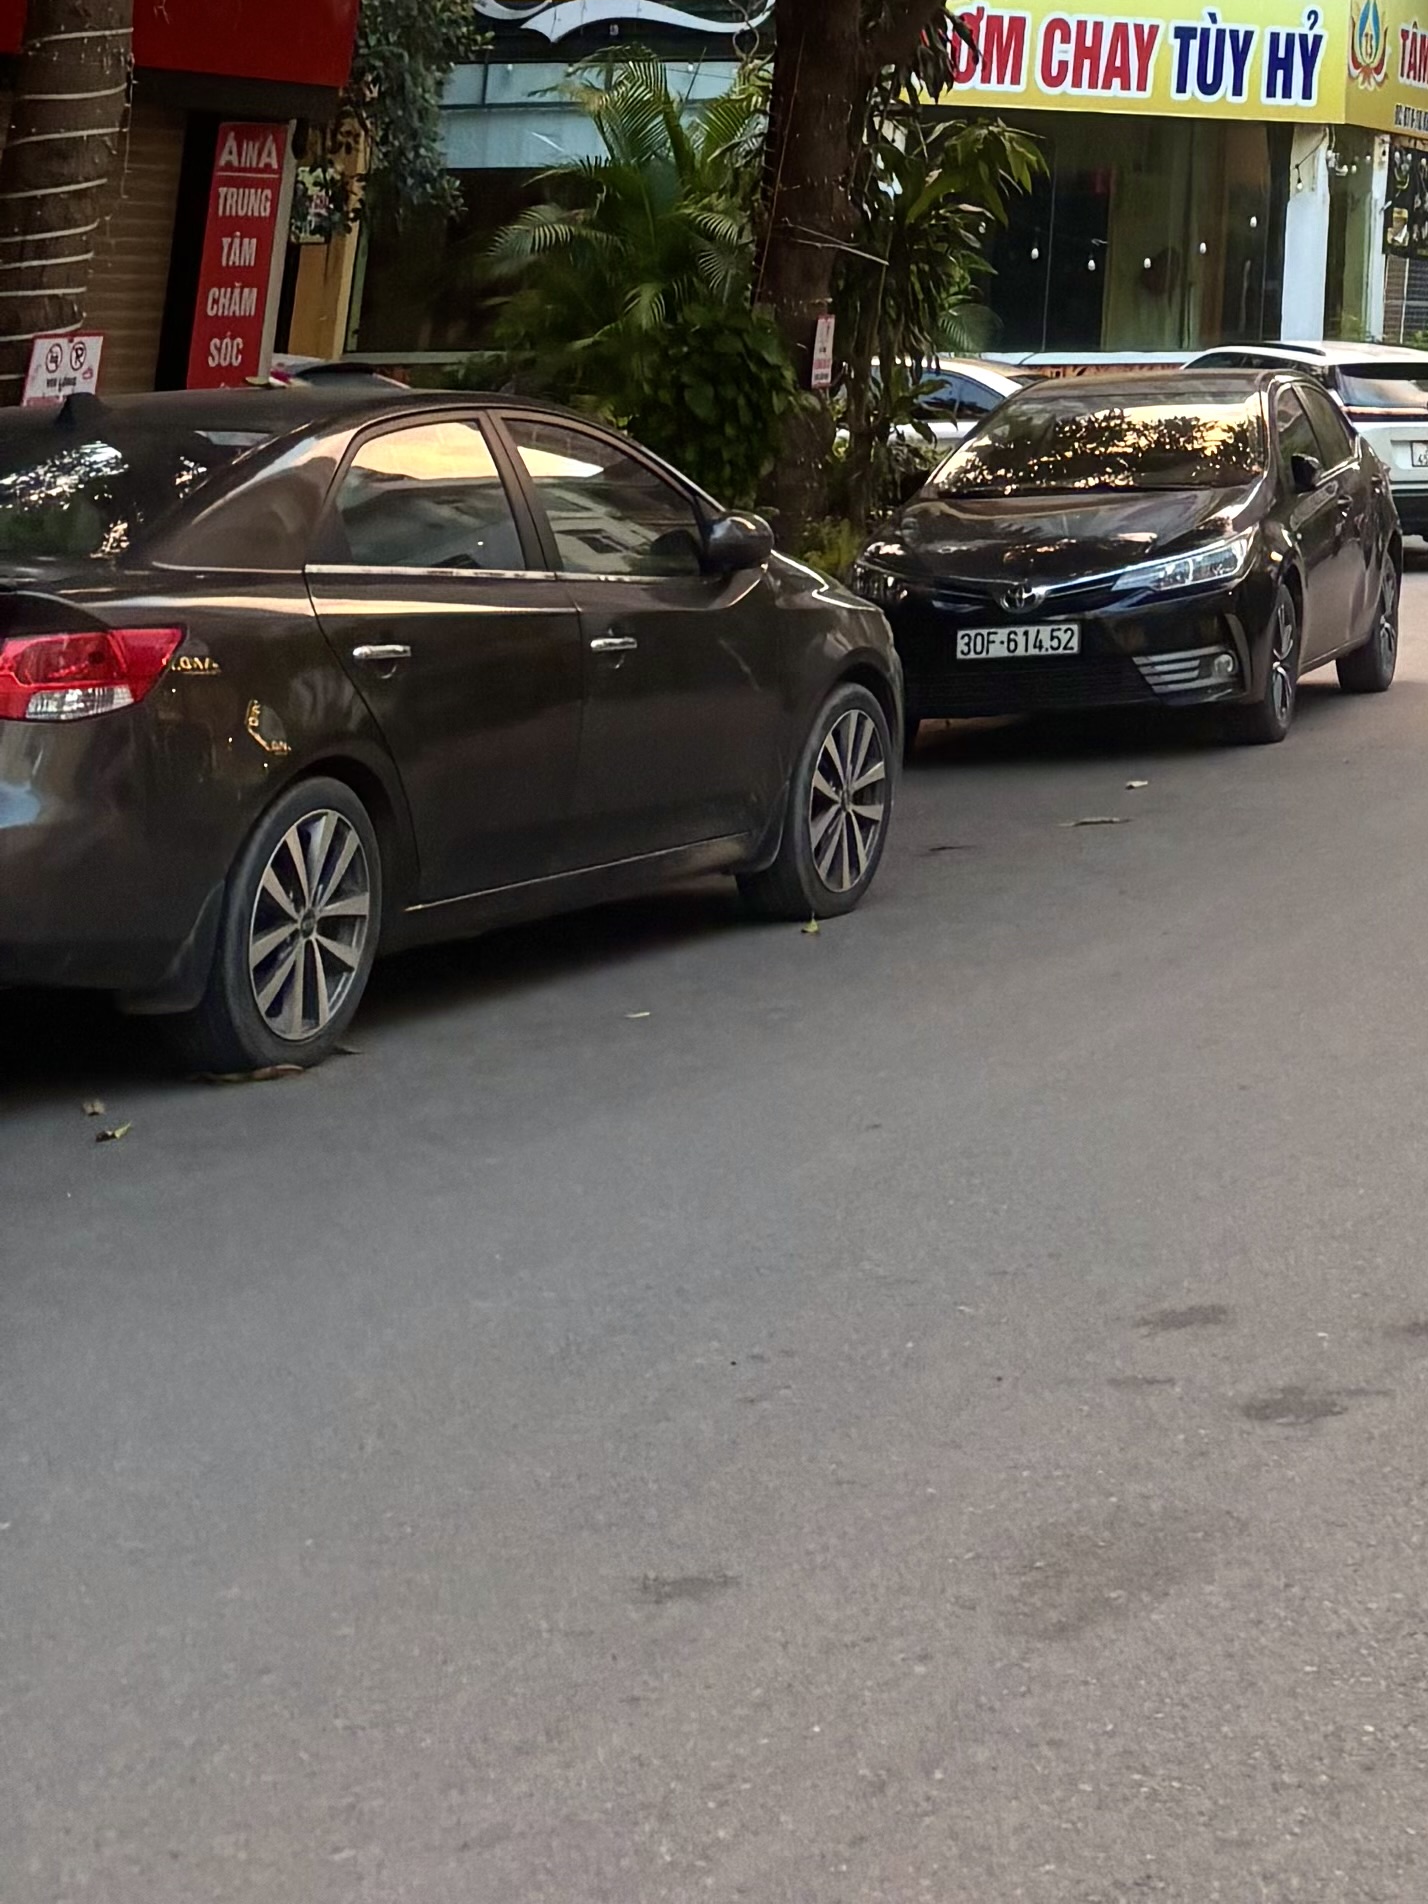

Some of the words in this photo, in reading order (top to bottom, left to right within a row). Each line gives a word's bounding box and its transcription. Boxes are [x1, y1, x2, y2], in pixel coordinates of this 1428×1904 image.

[921, 6, 1027, 85] ƠM
[1039, 17, 1160, 92] CHAY
[1173, 12, 1254, 98] TÙY
[1265, 9, 1324, 101] HỶ
[216, 187, 271, 218] TRUNG
[220, 231, 257, 267] TÂM
[206, 282, 258, 317] CHĂM
[207, 331, 243, 368] SÓC
[960, 627, 1075, 656] 30F-614.52
